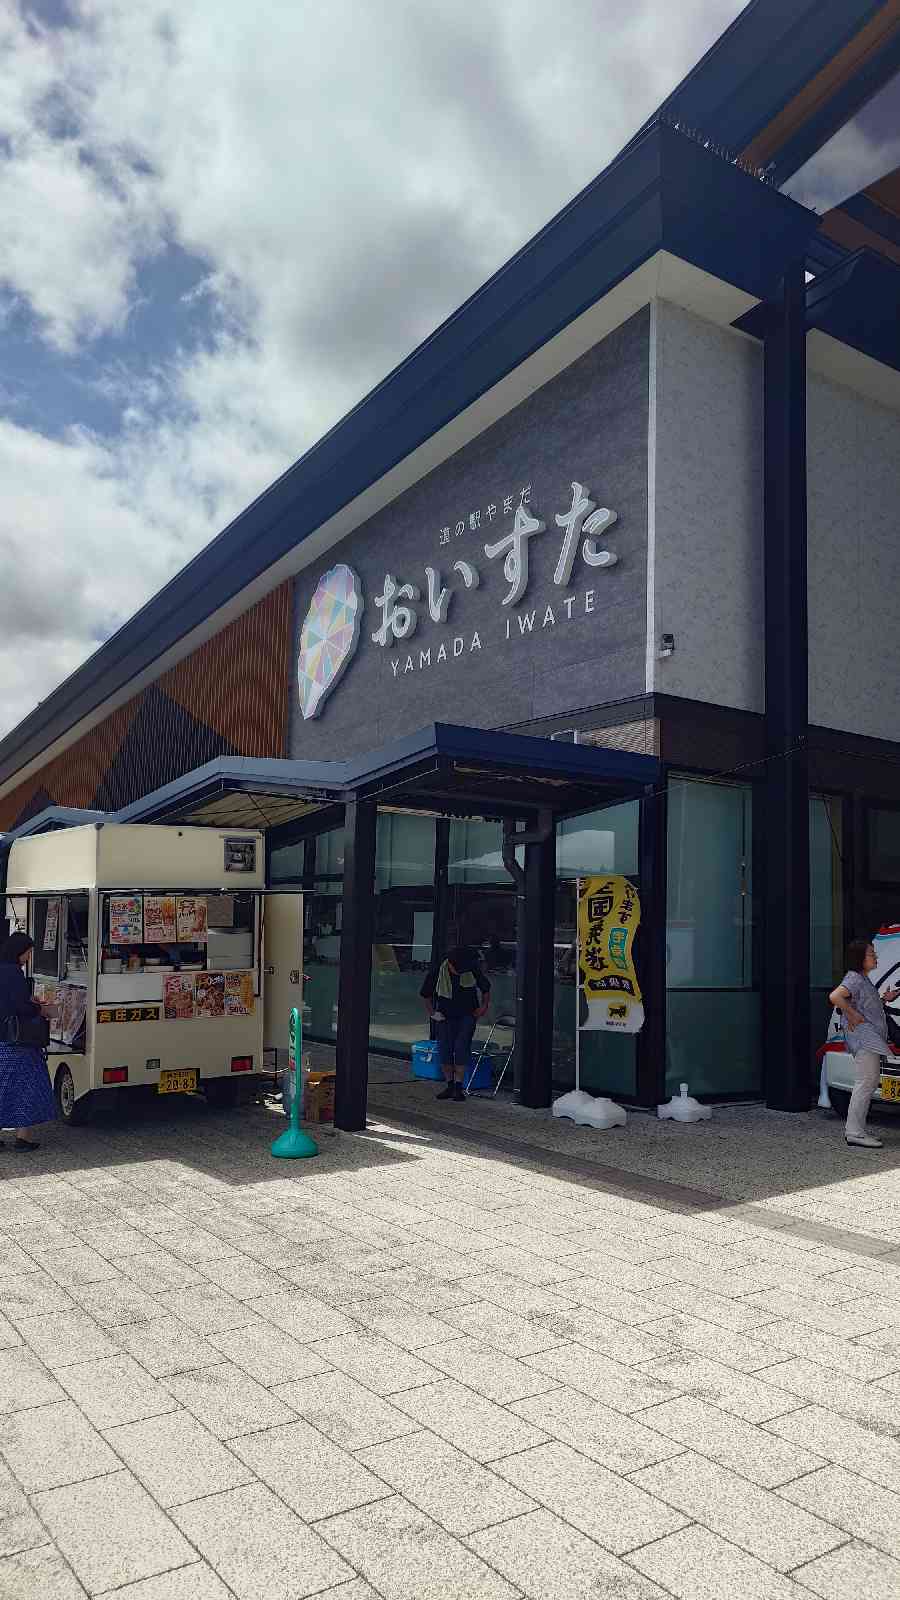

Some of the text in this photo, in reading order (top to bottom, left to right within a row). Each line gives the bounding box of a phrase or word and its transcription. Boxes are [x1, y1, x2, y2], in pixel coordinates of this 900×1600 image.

[439, 484, 532, 545] 道の駅やまだ
[371, 481, 618, 648] おいすた
[389, 589, 596, 677] YAMADA IWATE
